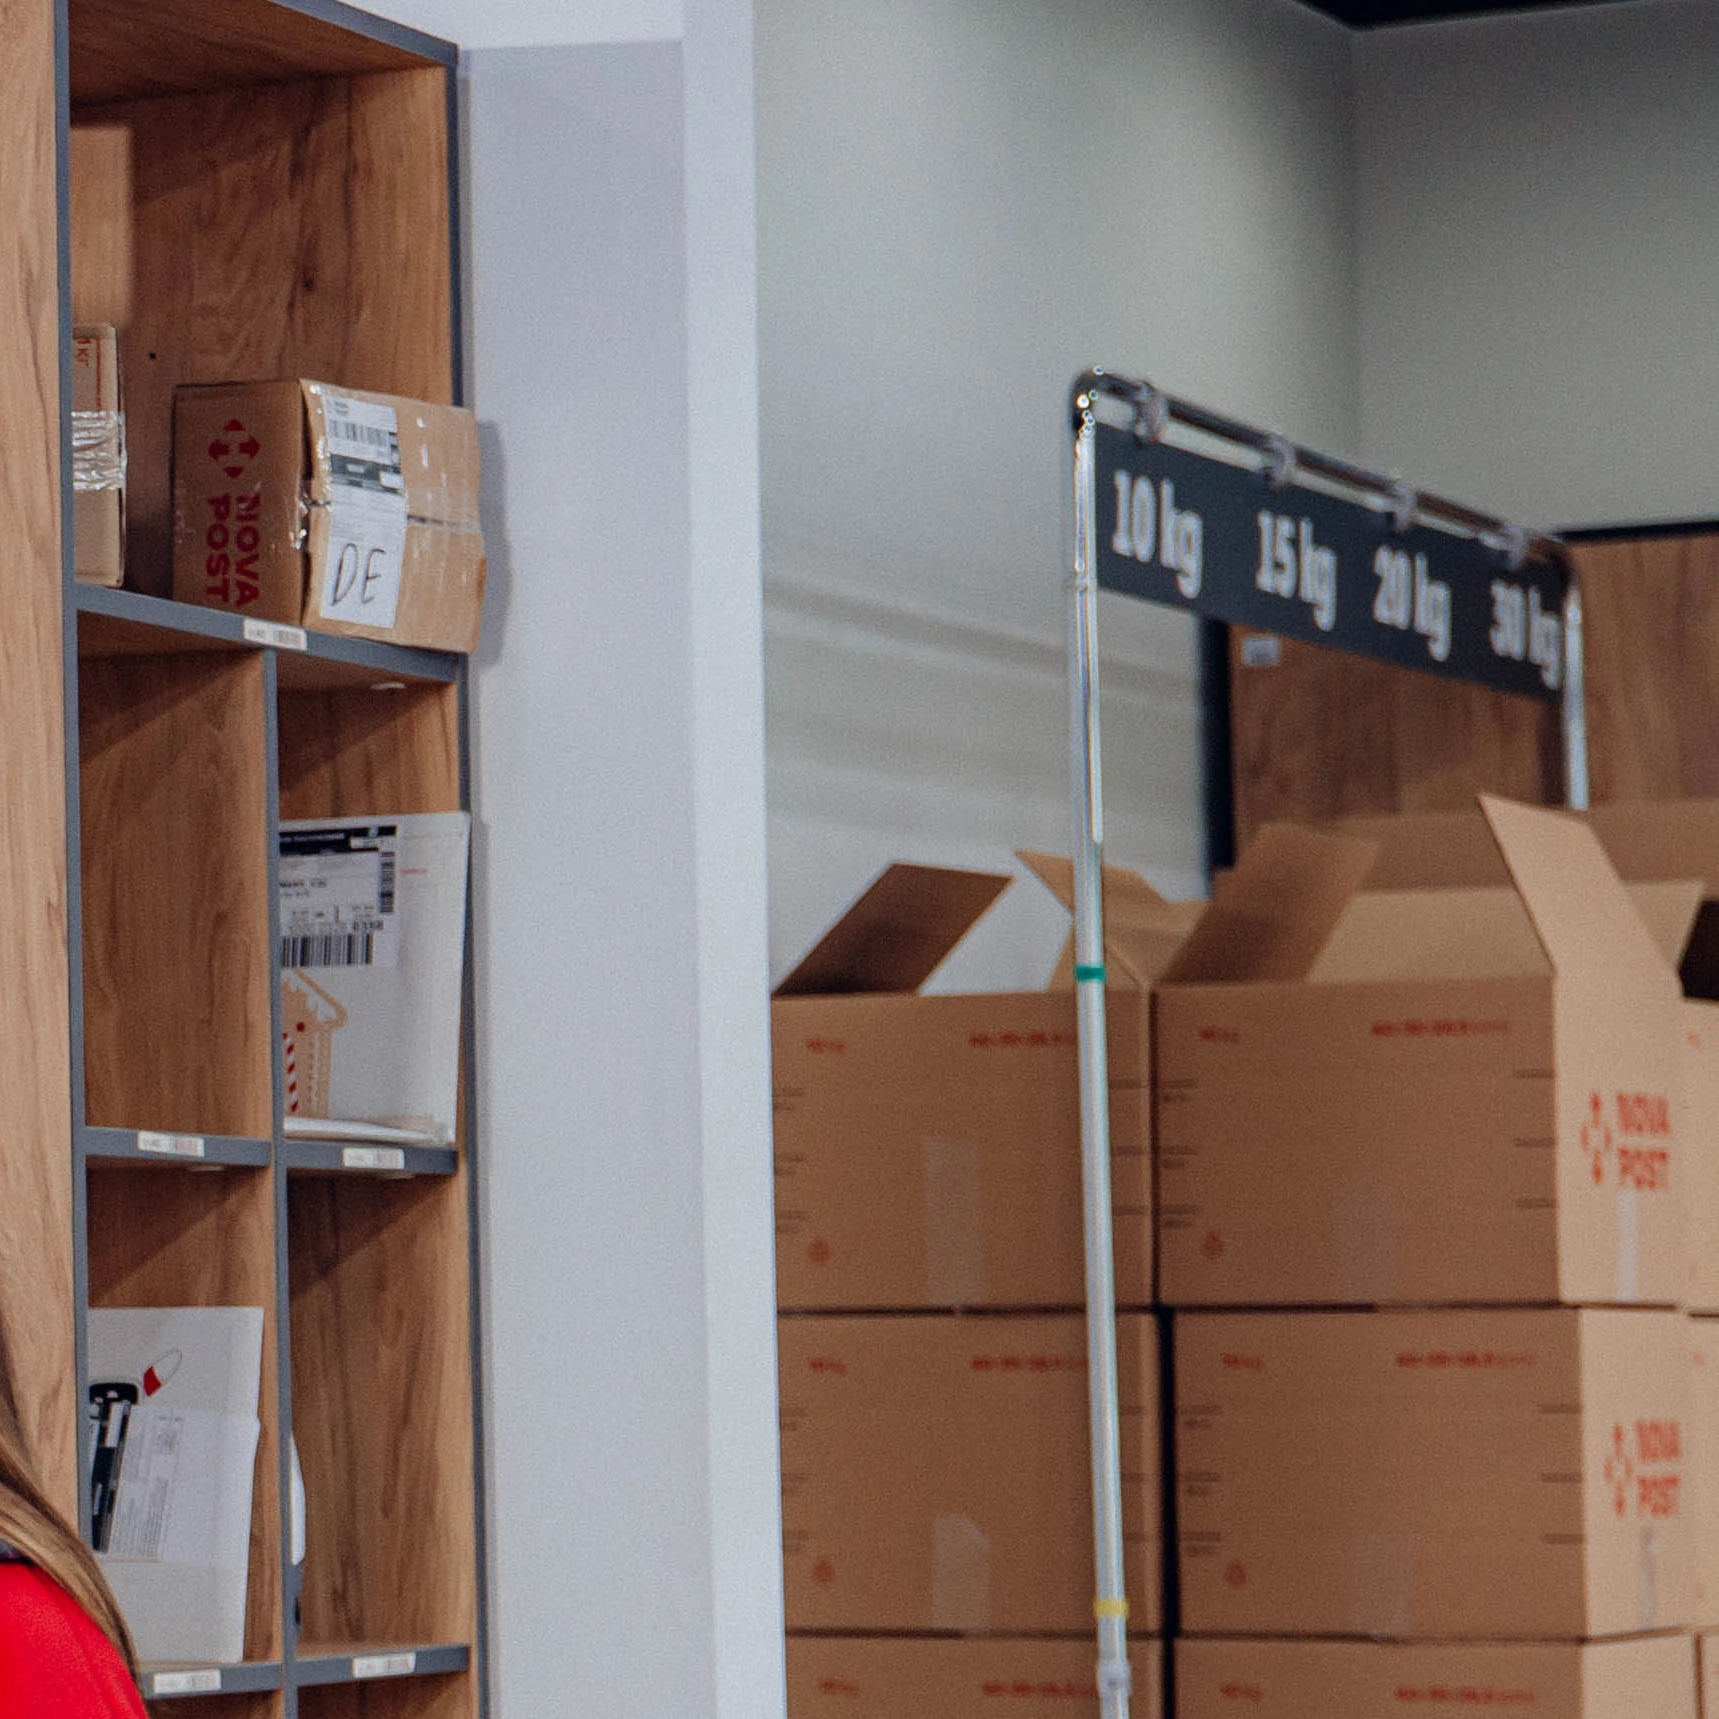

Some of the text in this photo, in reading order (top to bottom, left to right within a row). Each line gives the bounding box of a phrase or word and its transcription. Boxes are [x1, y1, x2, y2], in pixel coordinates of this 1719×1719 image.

[206, 494, 230, 603] POST
[235, 494, 261, 607] NOVA
[332, 541, 387, 606] DE
[1112, 467, 1203, 600] 10 kg
[1256, 510, 1338, 632] 15 kg
[1373, 545, 1452, 662] 20 kg
[1490, 579, 1563, 691] 30 kg
